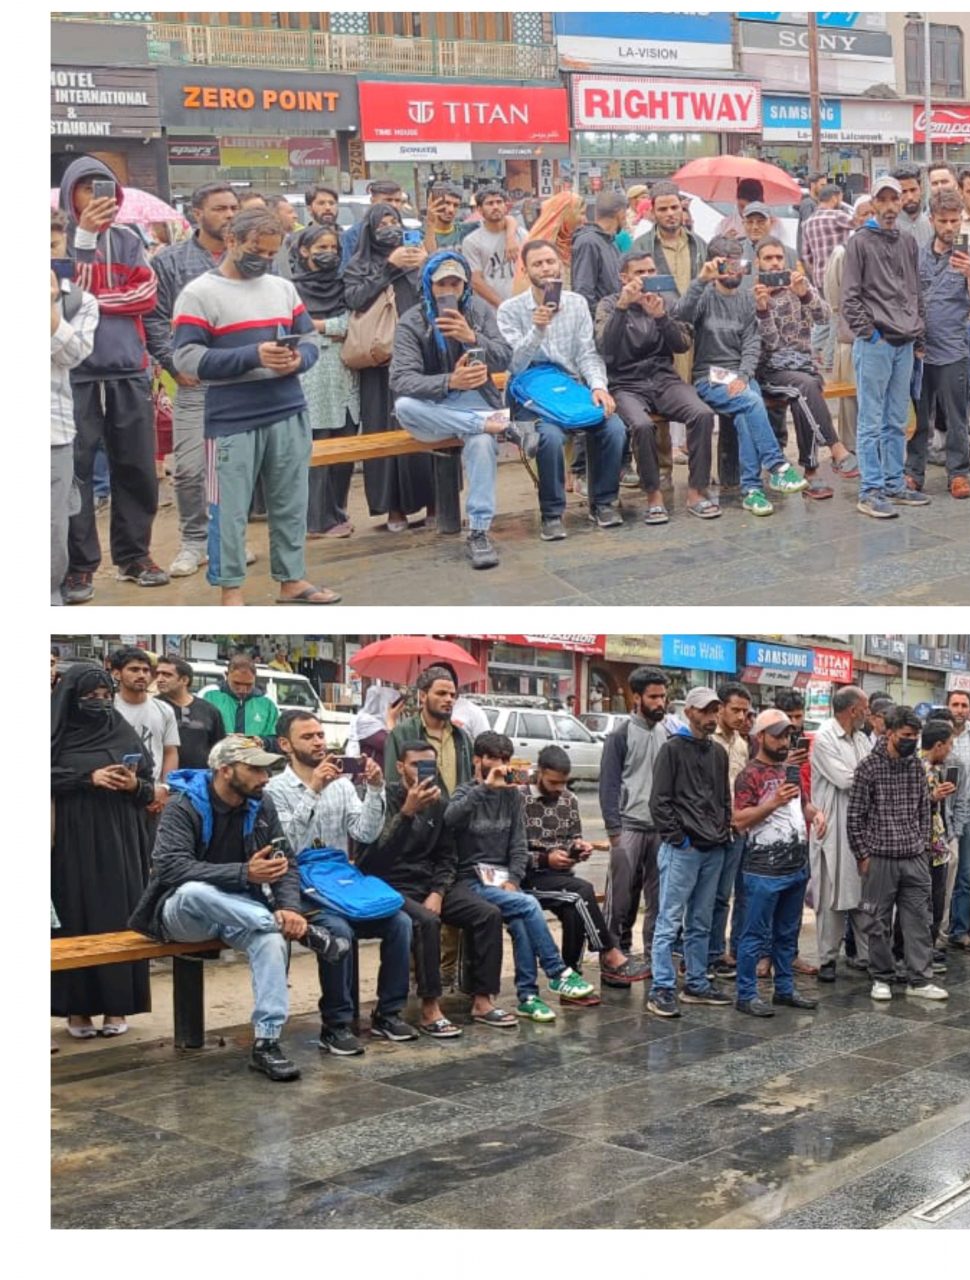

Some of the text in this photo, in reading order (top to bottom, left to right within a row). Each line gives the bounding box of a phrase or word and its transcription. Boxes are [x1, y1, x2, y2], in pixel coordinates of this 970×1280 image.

[778, 30, 856, 51] SONY
[618, 46, 678, 60] LA-VISION
[55, 89, 149, 106] INTERNATIONAL
[182, 86, 340, 112] ZERO POINT
[583, 88, 753, 121] RIGHTWAY
[67, 106, 77, 119] &
[443, 102, 529, 125] TITAN
[770, 105, 834, 121] SAMSNG
[223, 136, 283, 148] LIBERTY
[170, 145, 213, 157] sparx
[757, 648, 807, 668] SAMSUNG
[818, 653, 851, 670] TITAN
